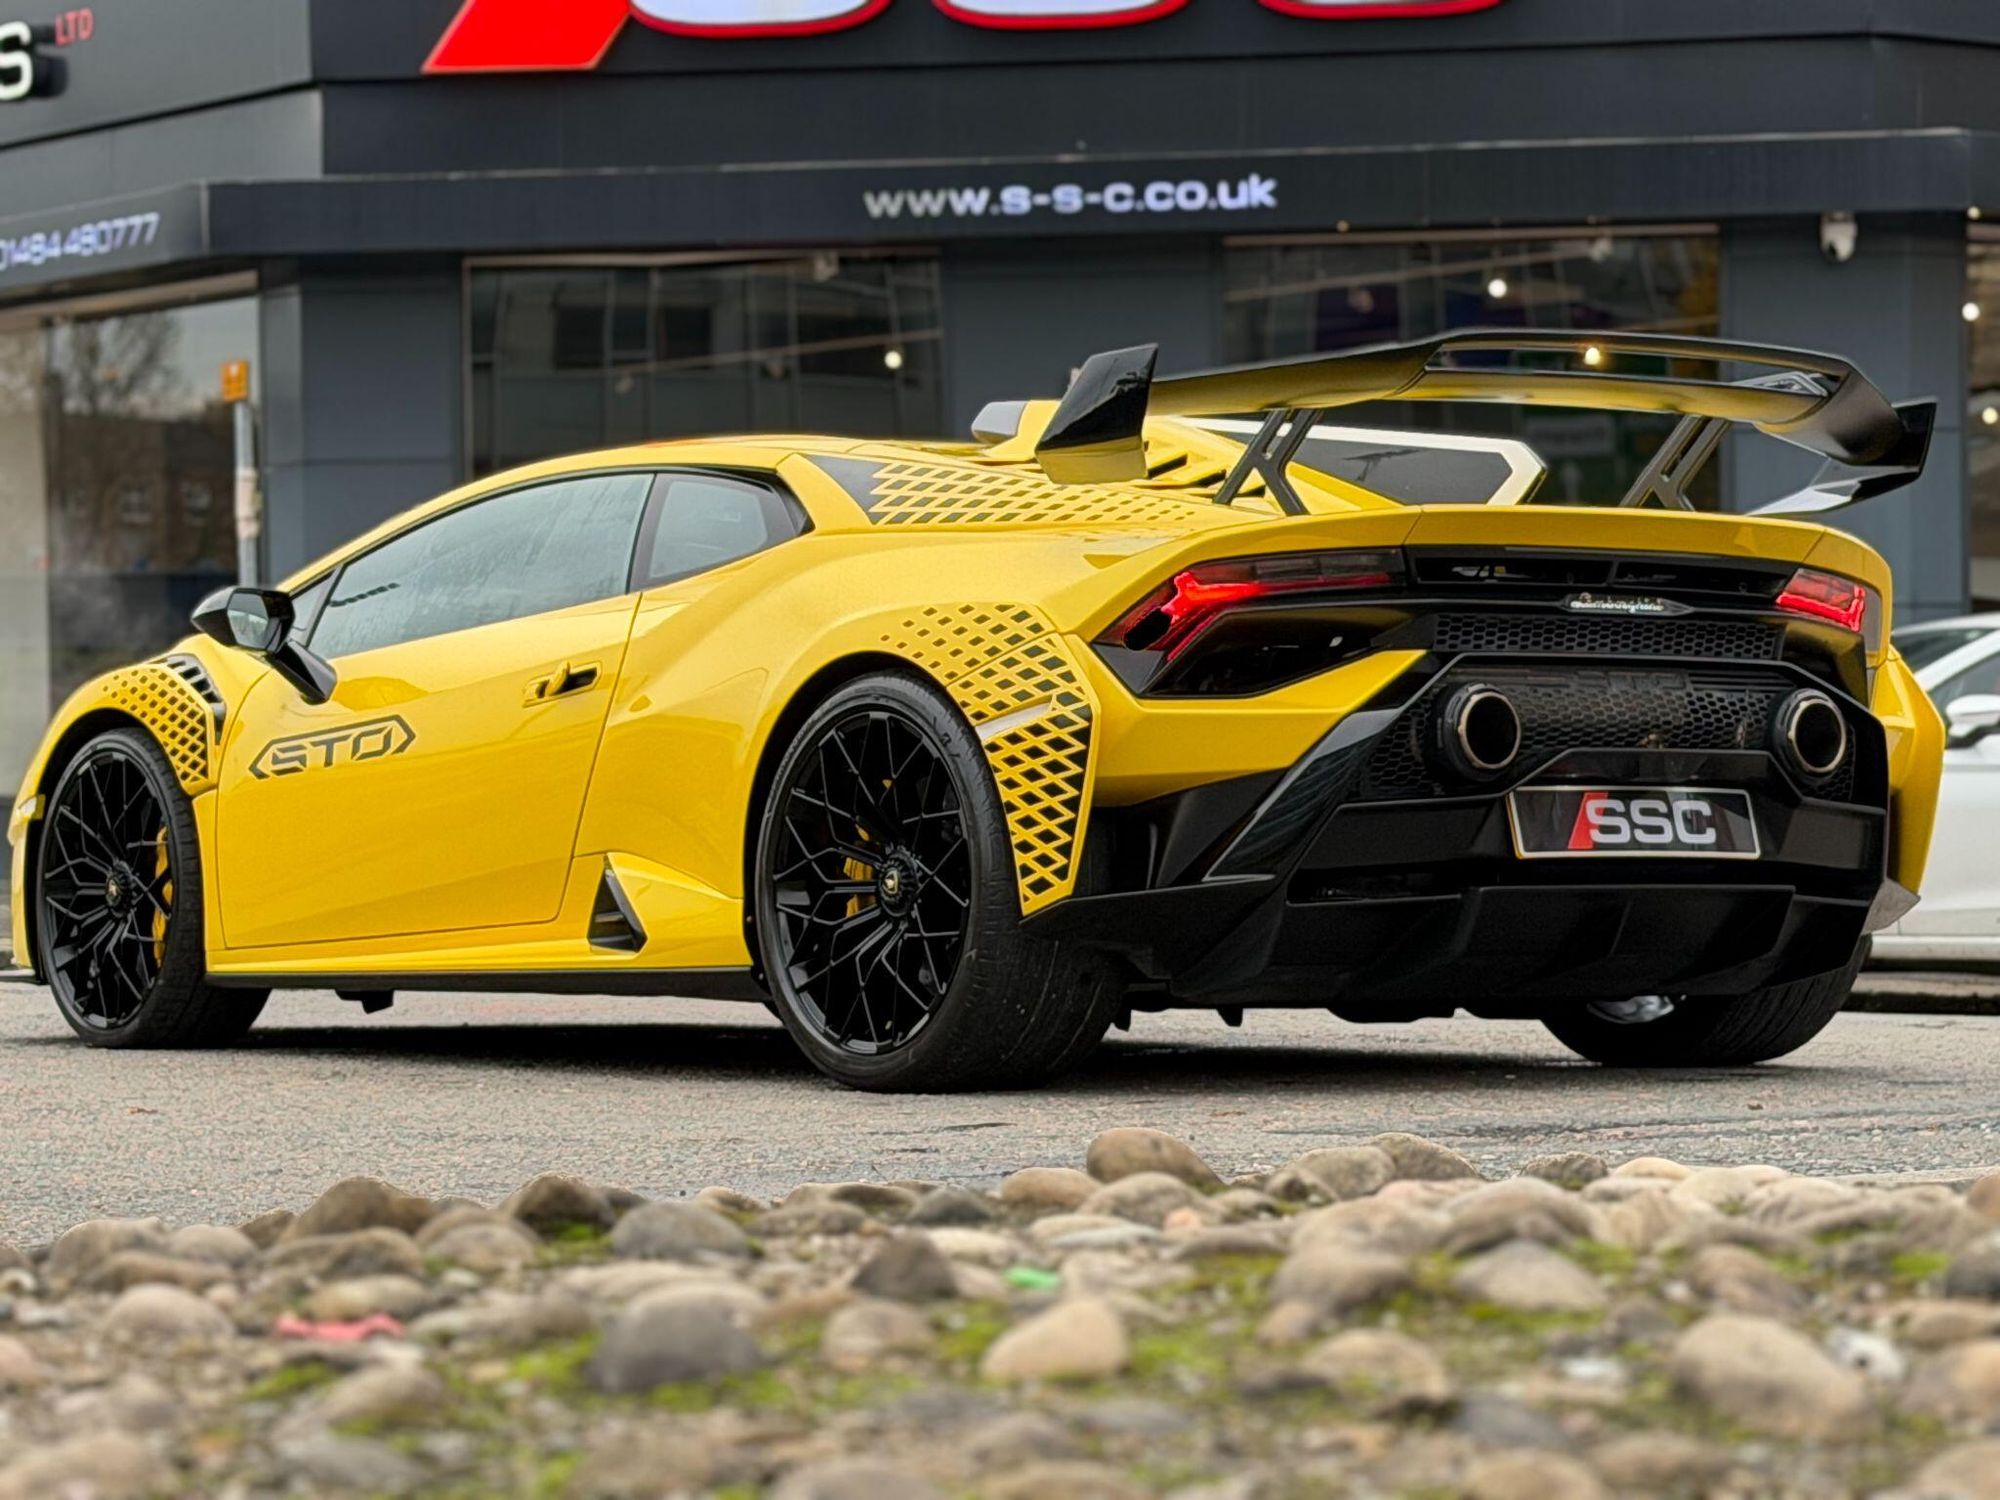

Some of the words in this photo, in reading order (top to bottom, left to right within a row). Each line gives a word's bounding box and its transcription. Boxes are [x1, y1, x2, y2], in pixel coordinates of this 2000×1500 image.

[54, 7, 94, 46] LTD
[863, 174, 1278, 218] www.s-s-c.co.uk
[270, 726, 394, 777] STO
[1585, 798, 1717, 845] SSC
